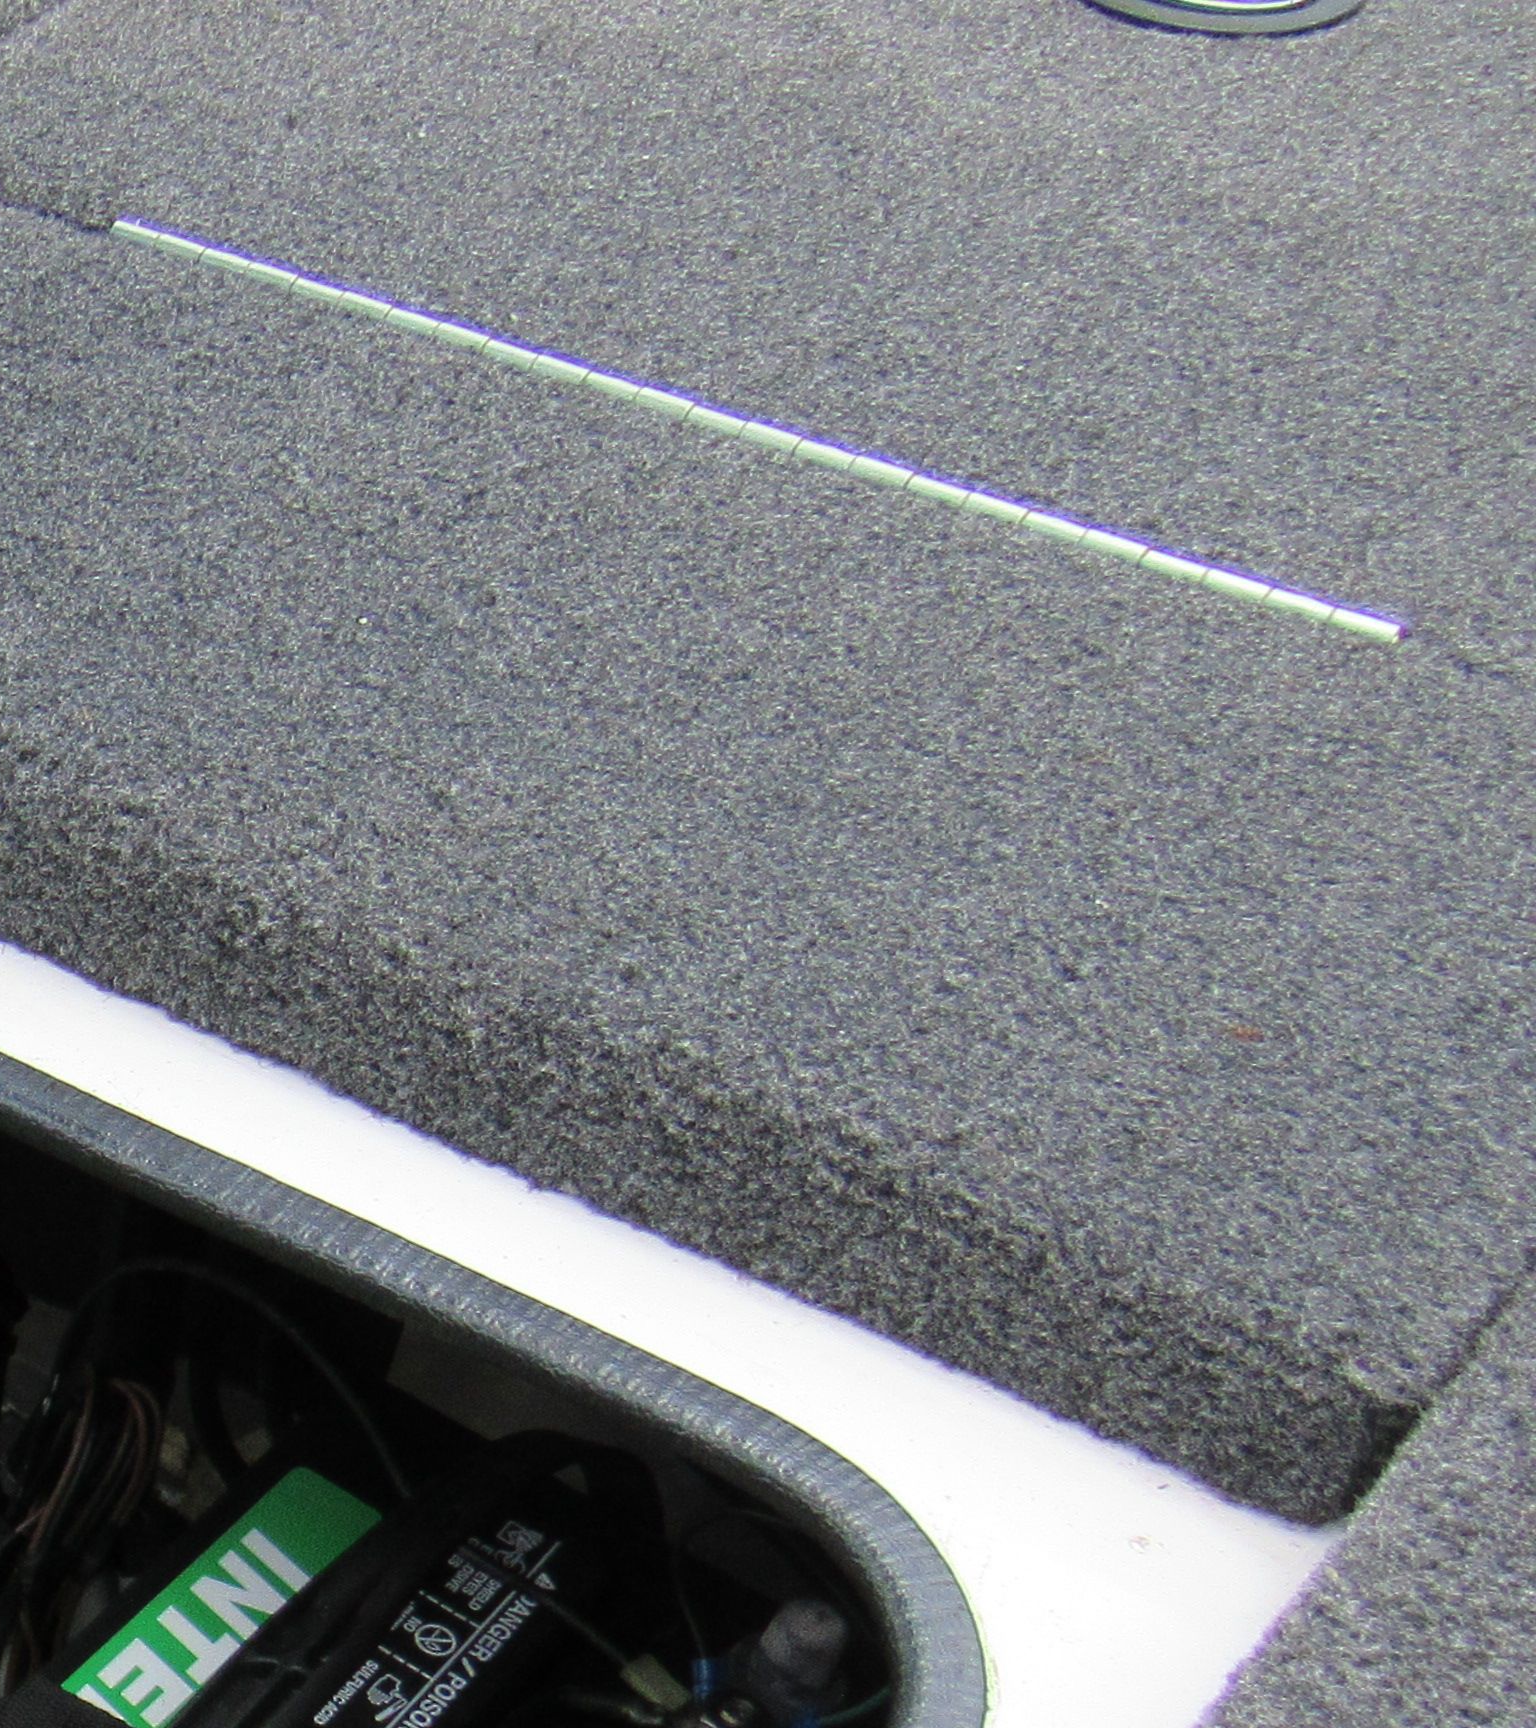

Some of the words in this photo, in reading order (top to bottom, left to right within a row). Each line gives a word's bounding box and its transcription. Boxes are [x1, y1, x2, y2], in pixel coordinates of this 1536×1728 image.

[461, 1569, 487, 1597] EYES
[466, 1576, 500, 1613] SHIELD
[401, 1614, 421, 1634] NO
[330, 1656, 379, 1708] SULFURIC
[310, 1700, 341, 1728] ACID
